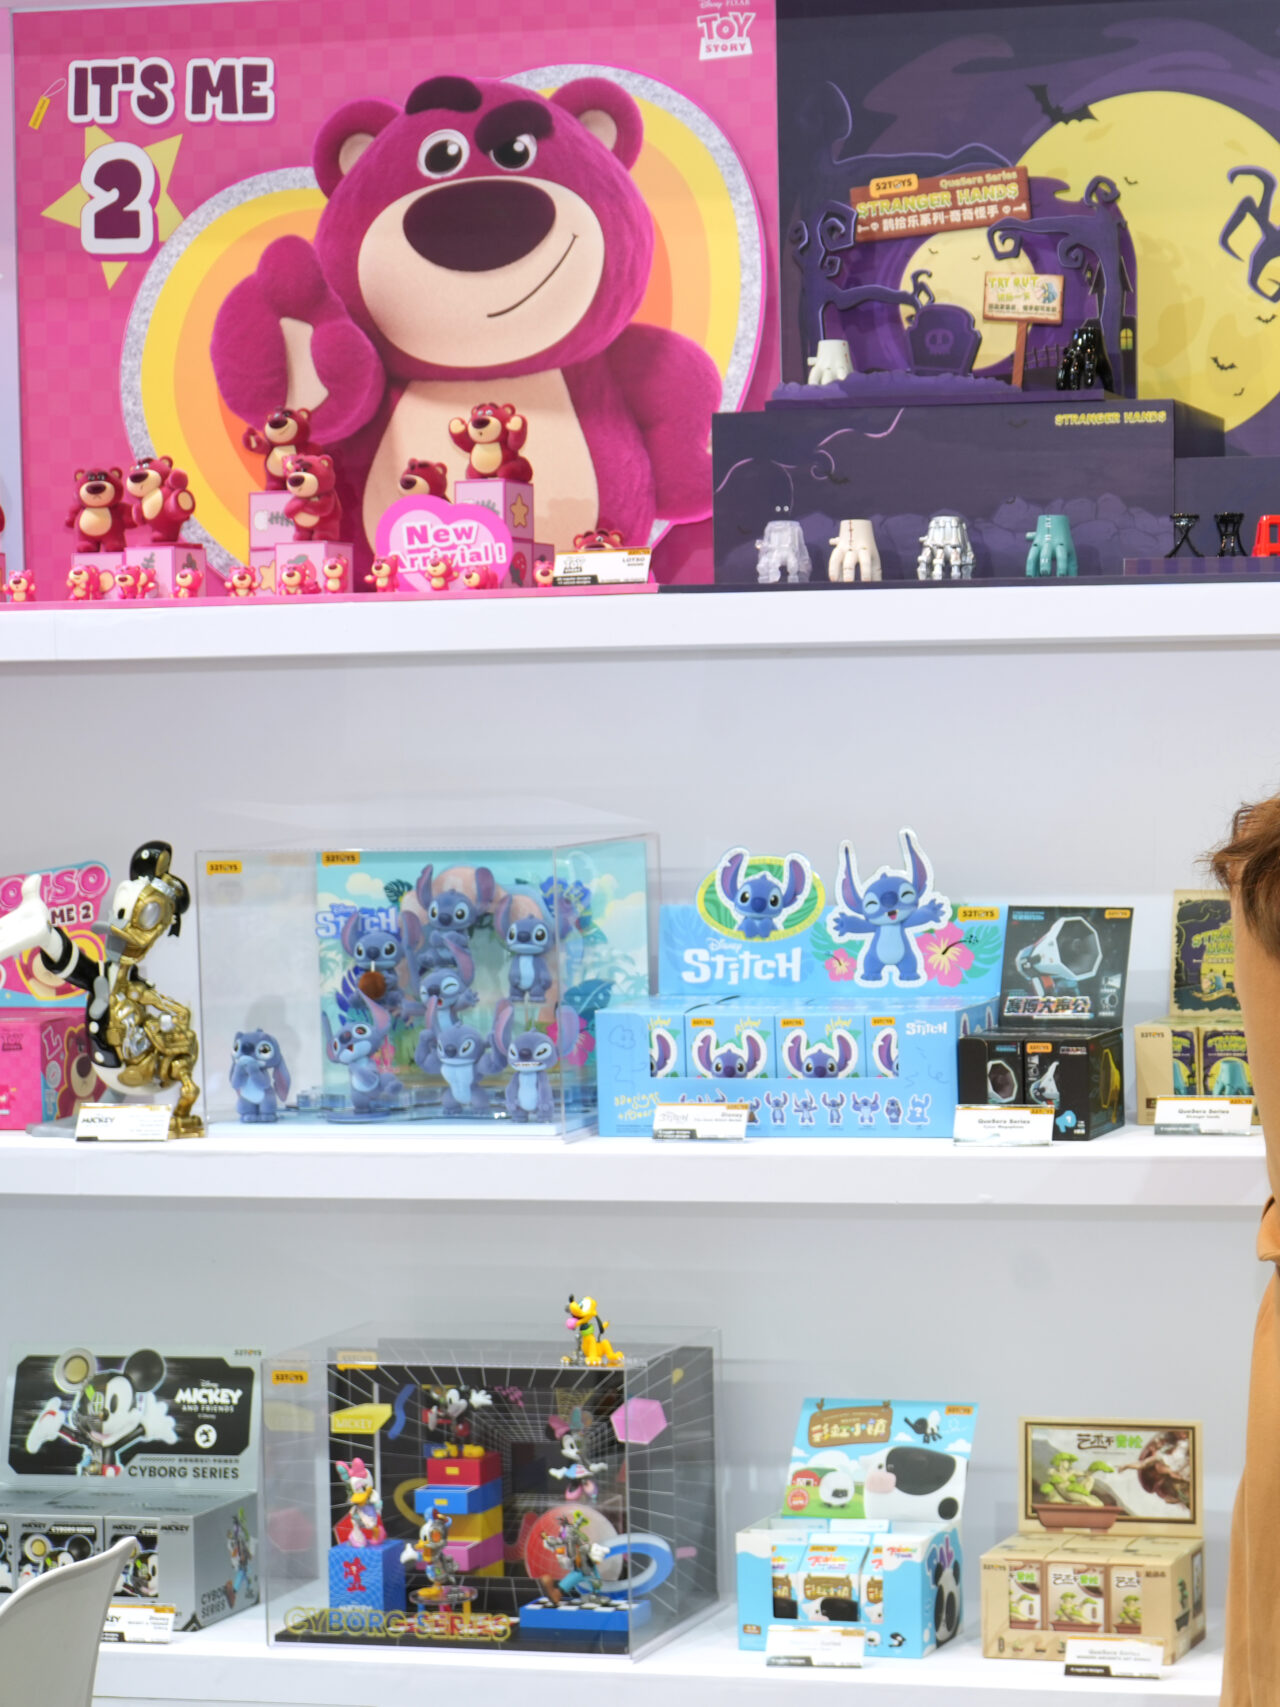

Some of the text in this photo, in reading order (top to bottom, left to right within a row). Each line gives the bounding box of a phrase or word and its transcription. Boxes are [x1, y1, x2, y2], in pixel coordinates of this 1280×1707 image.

[697, 12, 756, 40] TOY
[705, 43, 746, 53] STORY
[71, 61, 171, 119] IT'S
[190, 62, 270, 117] ME
[985, 171, 1018, 183] Series
[88, 151, 148, 246] 2
[856, 183, 1019, 219] STRANGER HANDS
[1055, 410, 1167, 426] STRANGER HANDS
[404, 523, 476, 548] New
[50, 904, 93, 925] ME 2
[962, 910, 995, 918] 52TOYS
[706, 937, 742, 953] Disney
[174, 1387, 243, 1405] MICKEY
[182, 1405, 234, 1413] AND FRIENDS
[128, 1465, 239, 1479] CYBORG SERIES
[201, 1601, 226, 1619] SERIES
[286, 1606, 511, 1642] CYBORG SERIES
